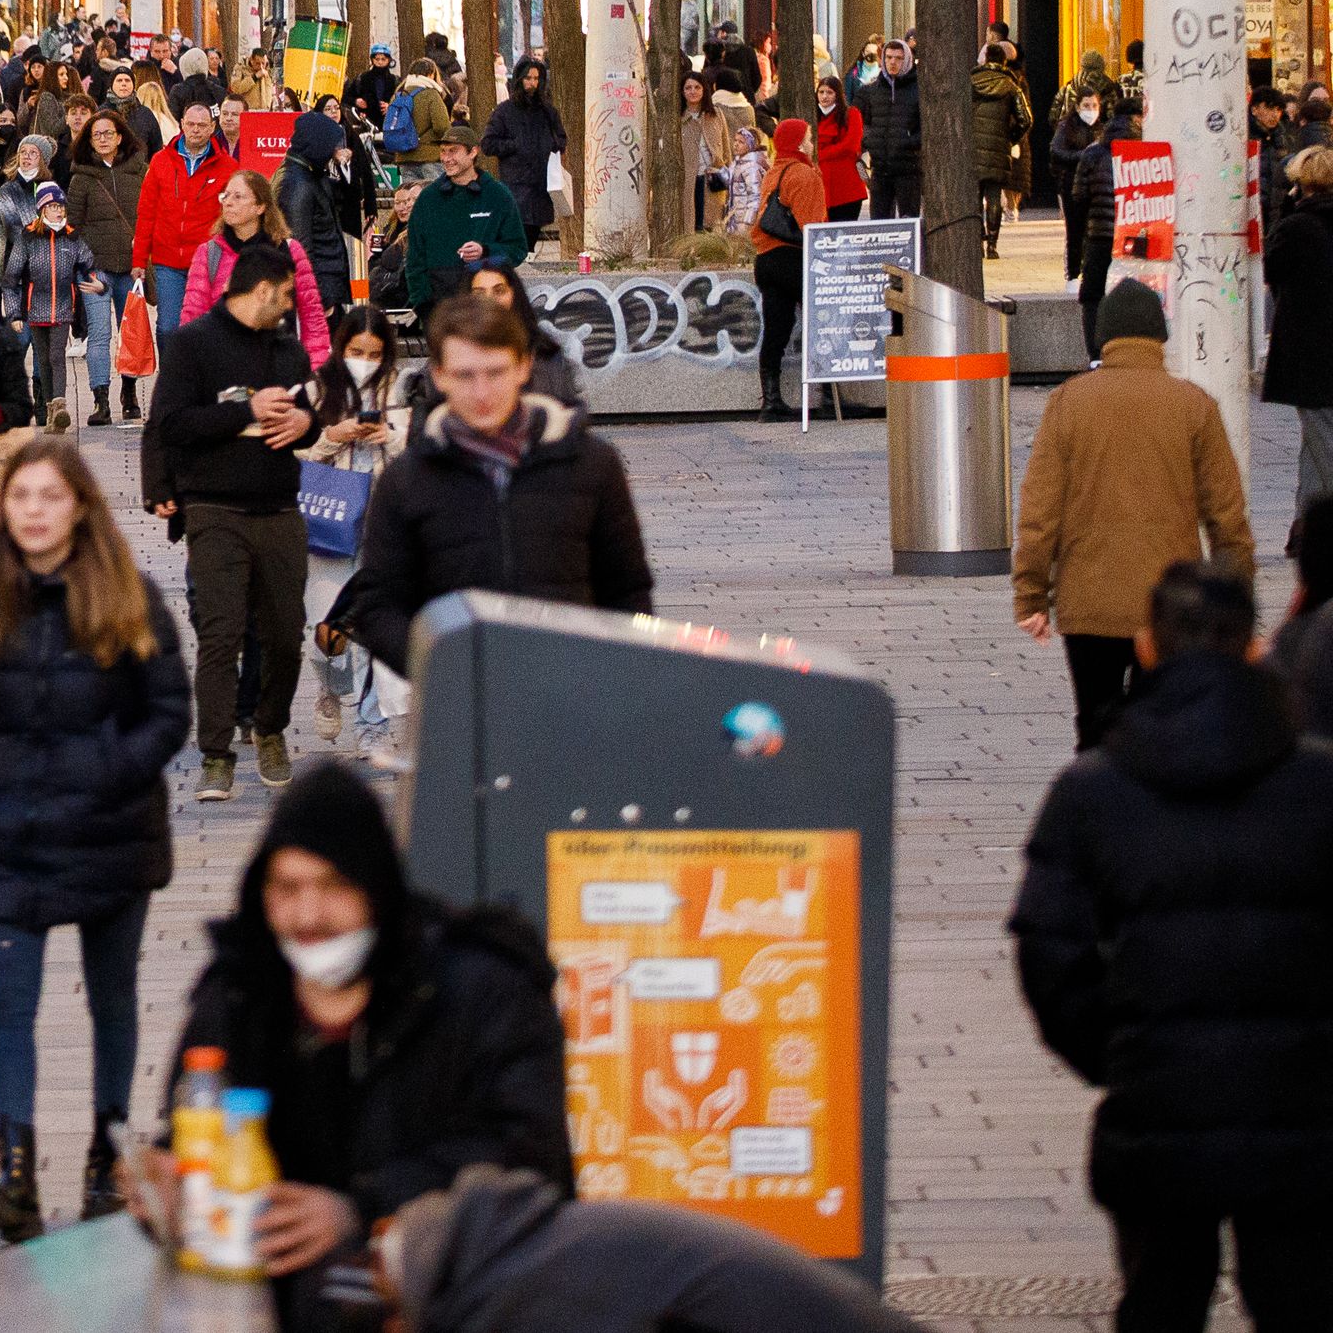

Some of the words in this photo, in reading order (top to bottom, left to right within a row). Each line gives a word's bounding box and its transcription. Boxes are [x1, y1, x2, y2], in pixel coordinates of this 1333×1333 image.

[1112, 154, 1173, 189] Kronen
[1115, 191, 1175, 227] Zeitung
[814, 231, 912, 250] dynamics
[815, 275, 861, 285] HOODIES
[815, 286, 845, 295] ARMY
[846, 284, 879, 293] PANTS
[815, 295, 875, 306] BACKPACKS
[839, 304, 887, 315] STICKERS
[831, 357, 869, 372] 20M
